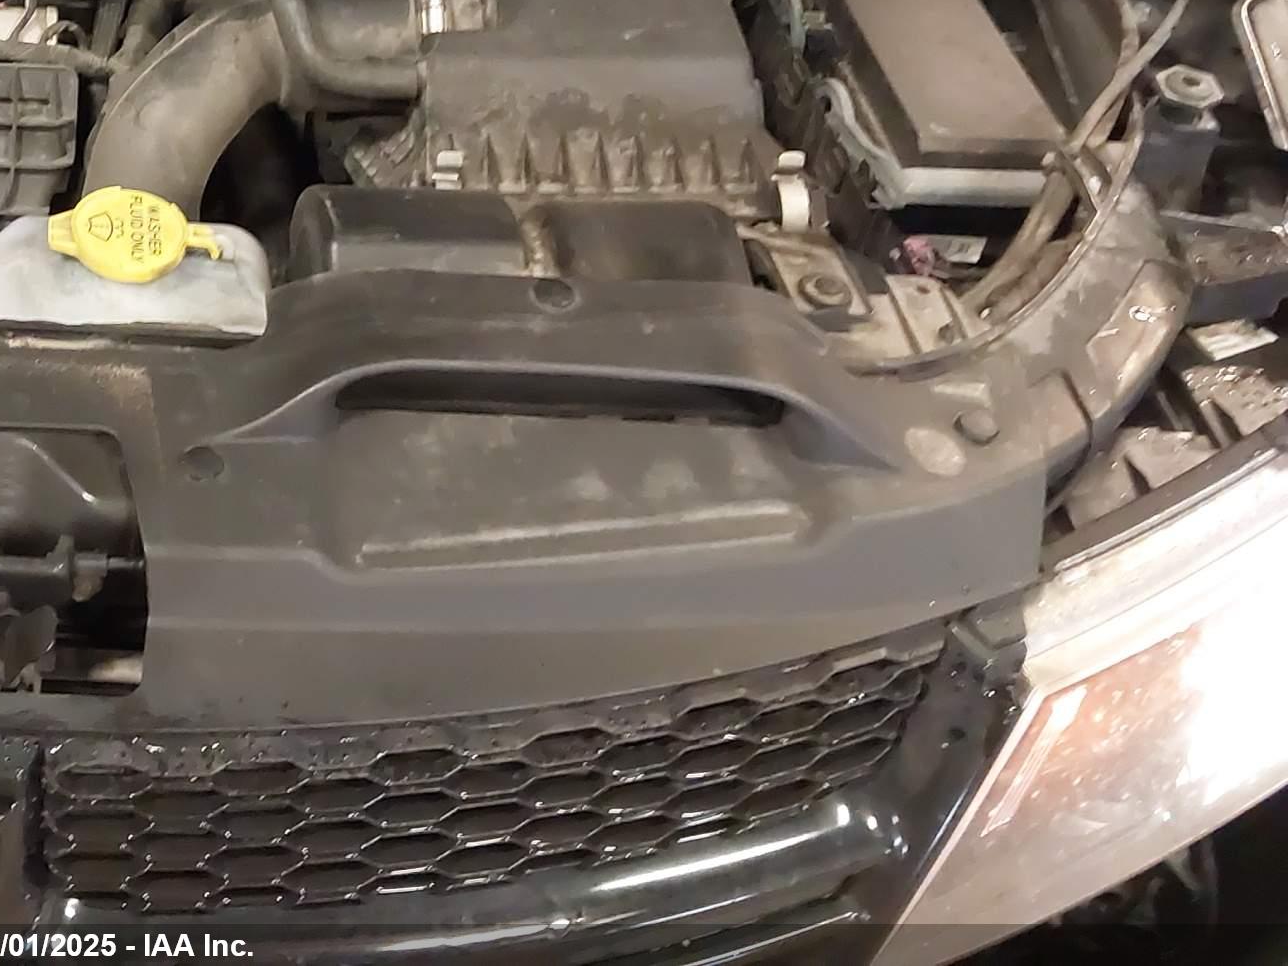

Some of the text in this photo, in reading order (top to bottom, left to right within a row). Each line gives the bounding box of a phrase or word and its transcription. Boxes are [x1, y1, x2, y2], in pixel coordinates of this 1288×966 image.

[130, 195, 144, 263] FLUID ONLY
[147, 205, 162, 256] WASHER
